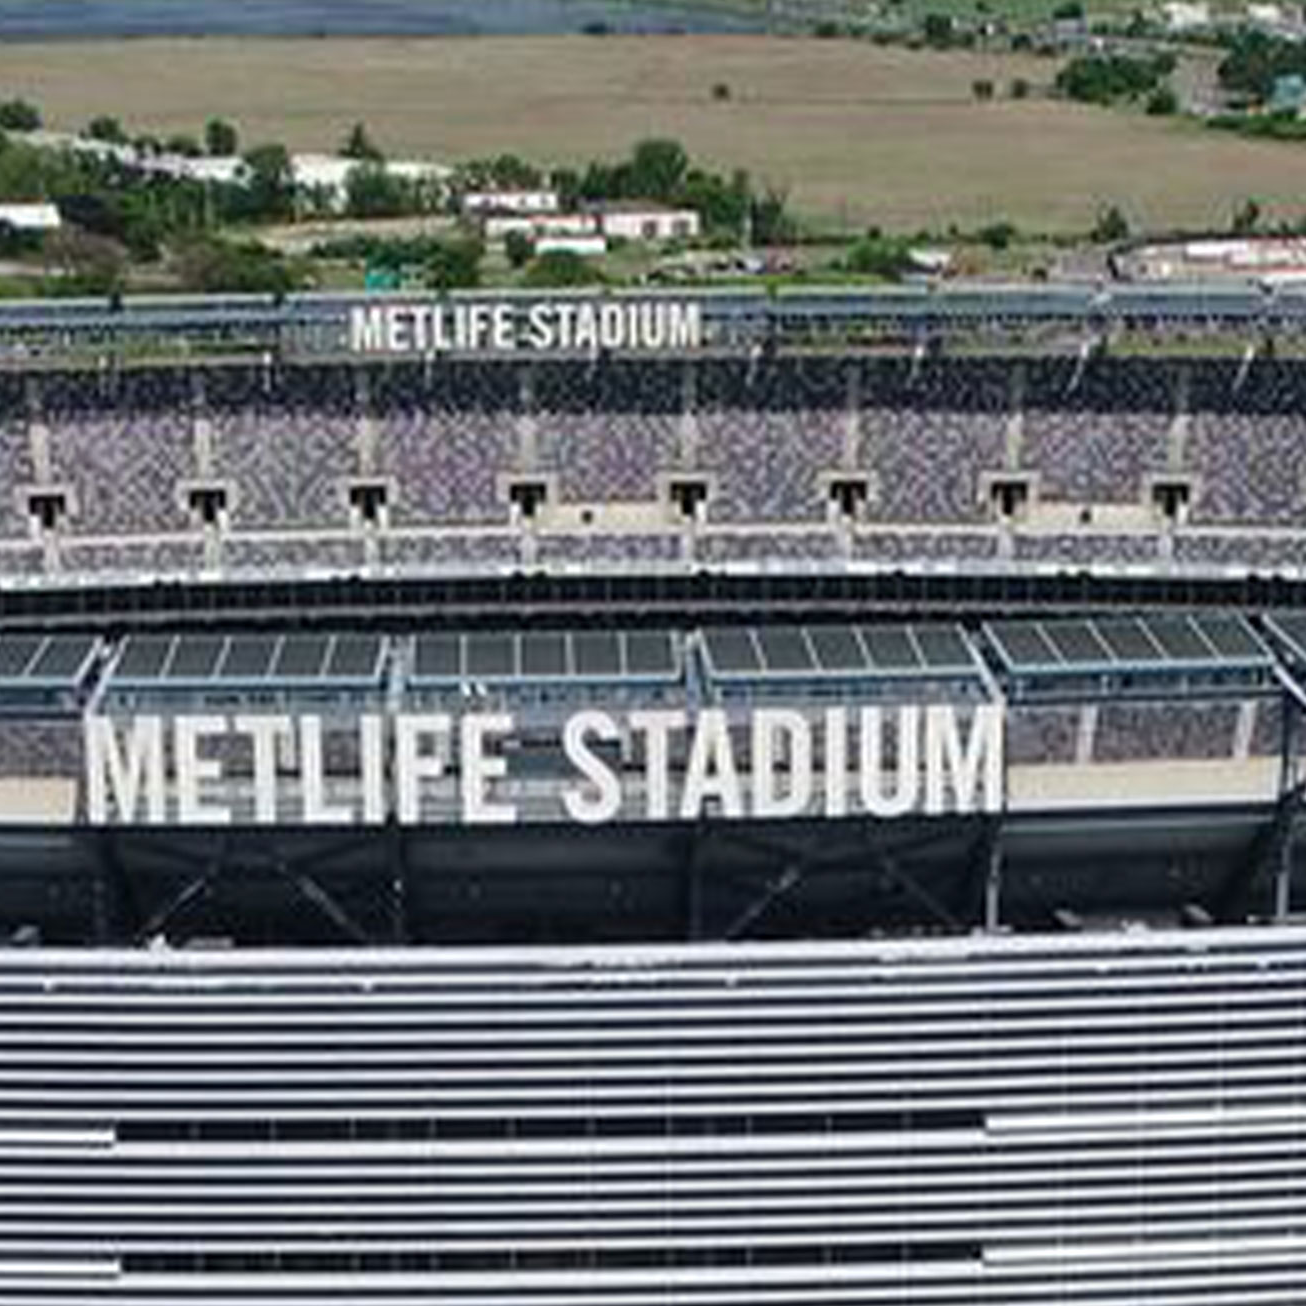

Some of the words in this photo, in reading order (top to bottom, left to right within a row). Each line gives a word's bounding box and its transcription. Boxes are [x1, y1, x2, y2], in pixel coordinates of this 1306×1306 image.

[350, 305, 515, 351] METLIFE
[529, 302, 700, 350] STADIUM
[84, 711, 518, 827] METLIFE
[564, 704, 1004, 824] STADIUM
